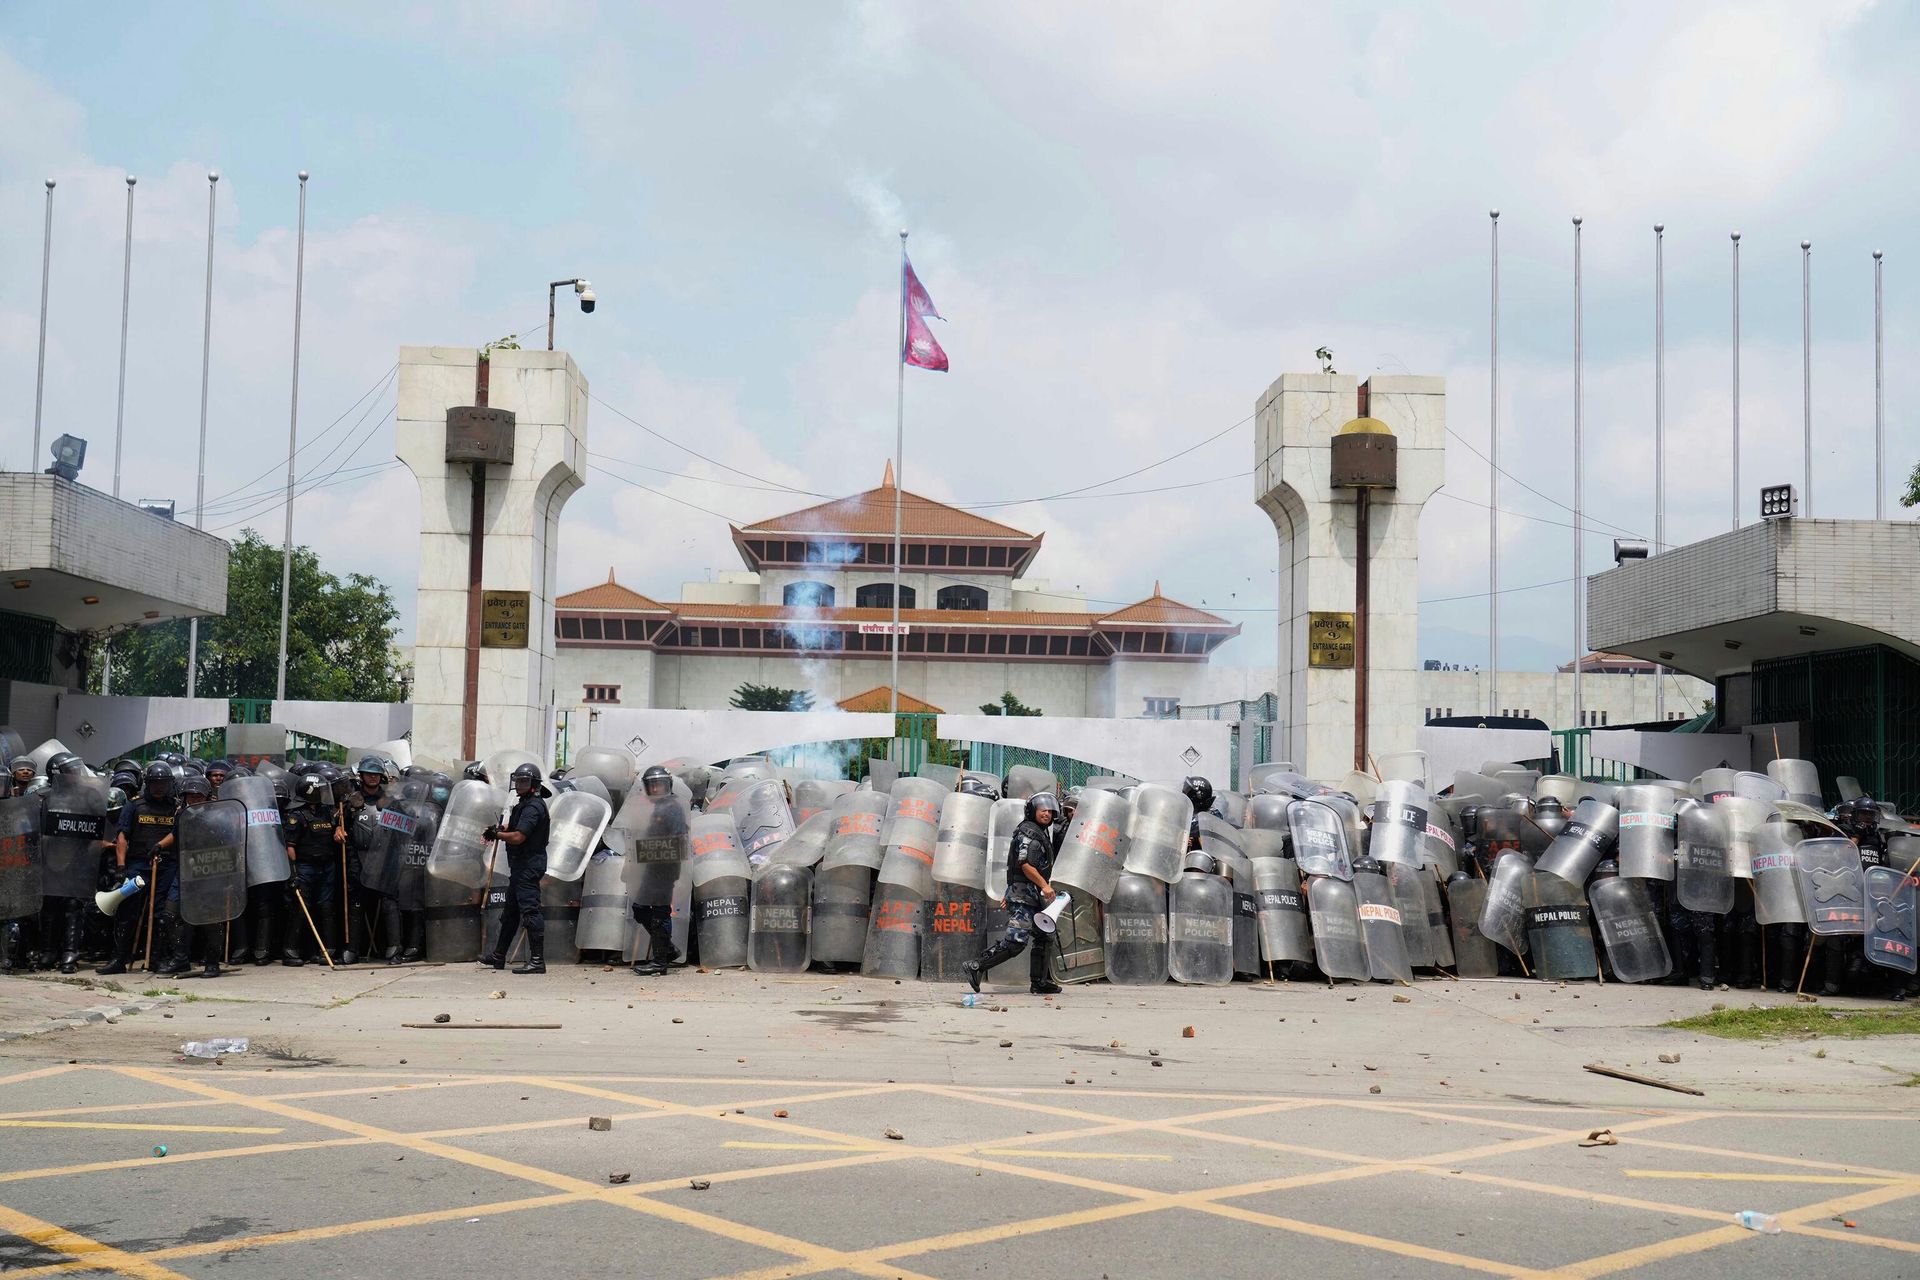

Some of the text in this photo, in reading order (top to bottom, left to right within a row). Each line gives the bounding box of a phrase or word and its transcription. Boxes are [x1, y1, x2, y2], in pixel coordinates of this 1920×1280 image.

[484, 621, 526, 630] ENTRANCE GATE
[1312, 642, 1352, 651] ENTRANCE GATE
[251, 811, 280, 823] POLICE
[382, 811, 404, 830] NEPAL
[1620, 814, 1674, 827] NEPAL POLICE
[58, 819, 97, 833] NEPAL POLICE
[1426, 824, 1440, 836] EPAL
[1569, 825, 1584, 836] NEPAL
[640, 839, 675, 850] NEPAL
[1307, 836, 1335, 848] POLICE
[196, 849, 231, 863] NEPAL
[639, 850, 678, 861] POLICE
[1693, 846, 1722, 858] NEPAL
[1861, 848, 1880, 857] NEPAL
[1692, 857, 1723, 867] POLICE
[1753, 857, 1777, 871] NEPAL
[1861, 855, 1880, 864] POLICE
[193, 860, 234, 875] POLICE
[490, 892, 506, 903] NEPAL
[706, 898, 738, 908] NEPAL
[1264, 894, 1298, 906] NEPAL POLICE
[706, 907, 740, 918] POLICE
[764, 908, 797, 919] NEPAL
[1360, 906, 1384, 918] NEPAL
[1384, 907, 1400, 922] POLICE
[1534, 911, 1581, 923] NEPAL POLICE
[763, 919, 799, 929] POLICE
[934, 918, 975, 933] NEPAL
[1119, 918, 1152, 927] NEPAL
[1185, 918, 1217, 928] NEPAL
[1615, 918, 1645, 930] NEPAL
[1119, 928, 1153, 937] POLICE
[1184, 928, 1219, 938] POLICE
[1616, 926, 1649, 938] POLICE
